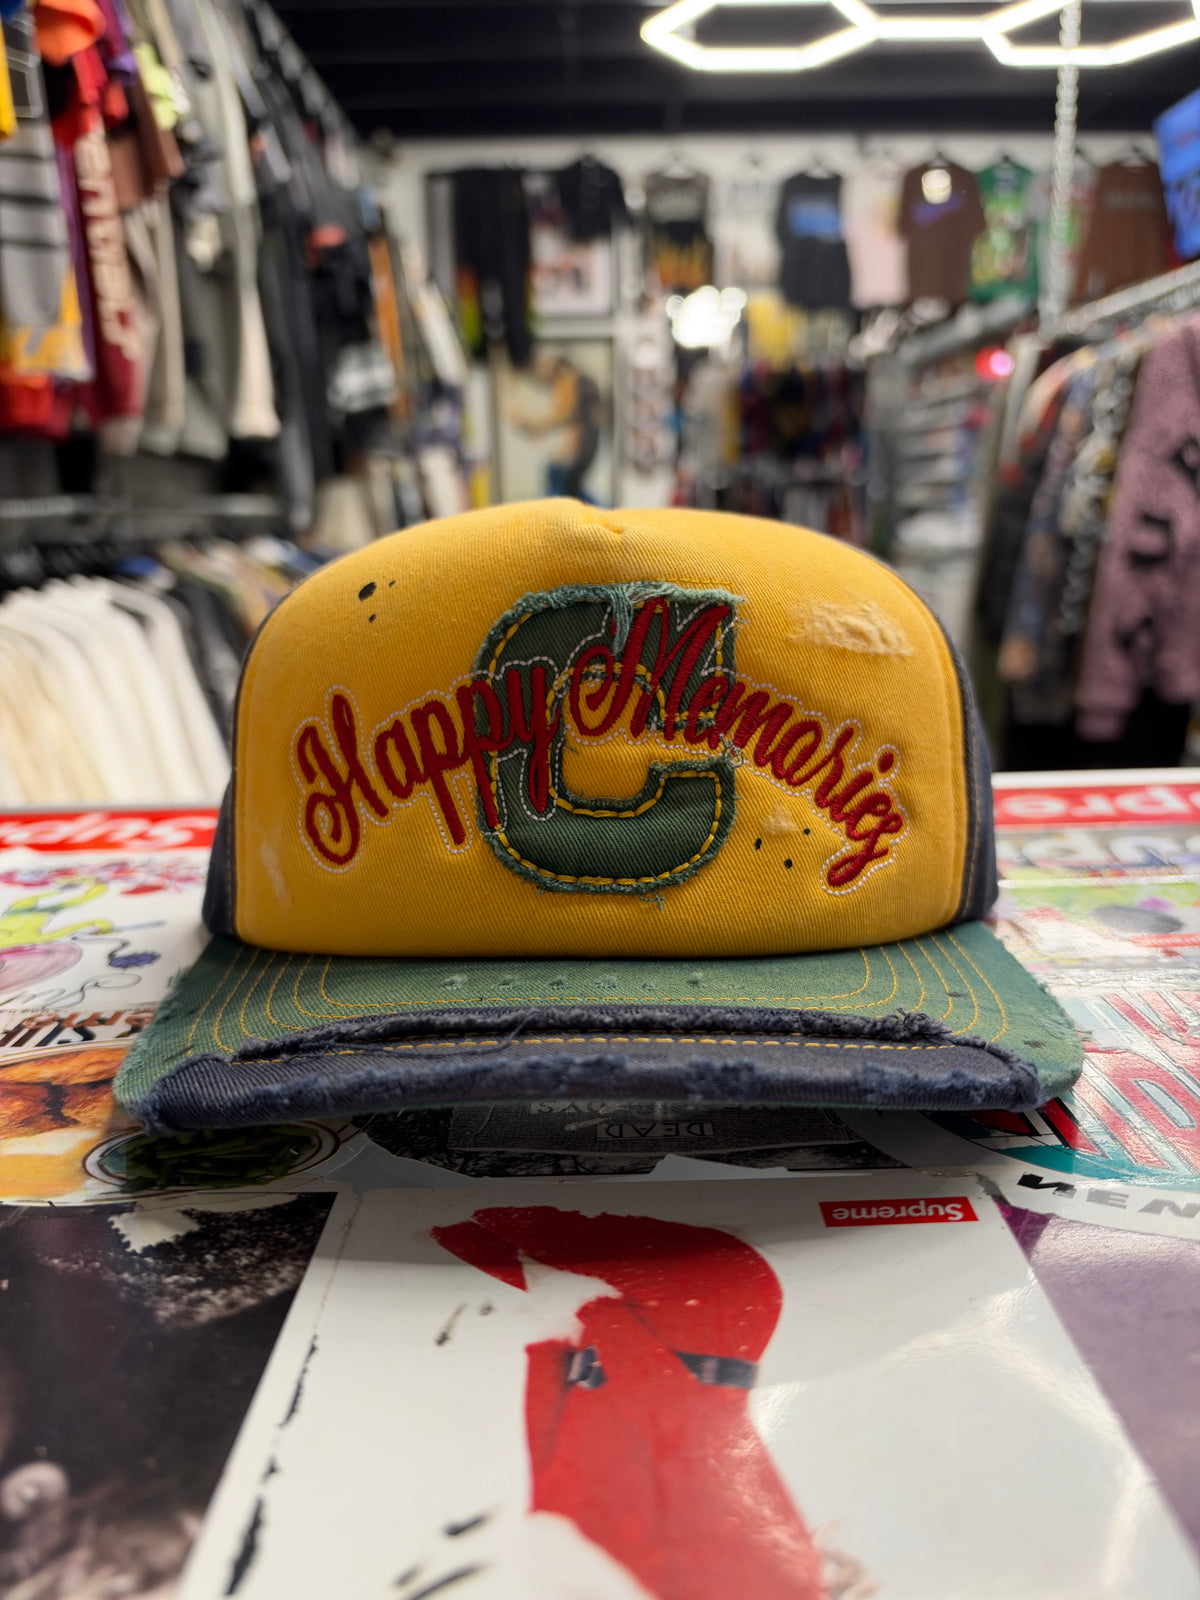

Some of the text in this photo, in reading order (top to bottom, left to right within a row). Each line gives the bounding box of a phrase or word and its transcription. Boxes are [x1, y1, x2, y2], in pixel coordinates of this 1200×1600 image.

[297, 597, 904, 888] Happy Memories
[604, 1122, 705, 1139] DEAD
[832, 1199, 965, 1222] Supreme
